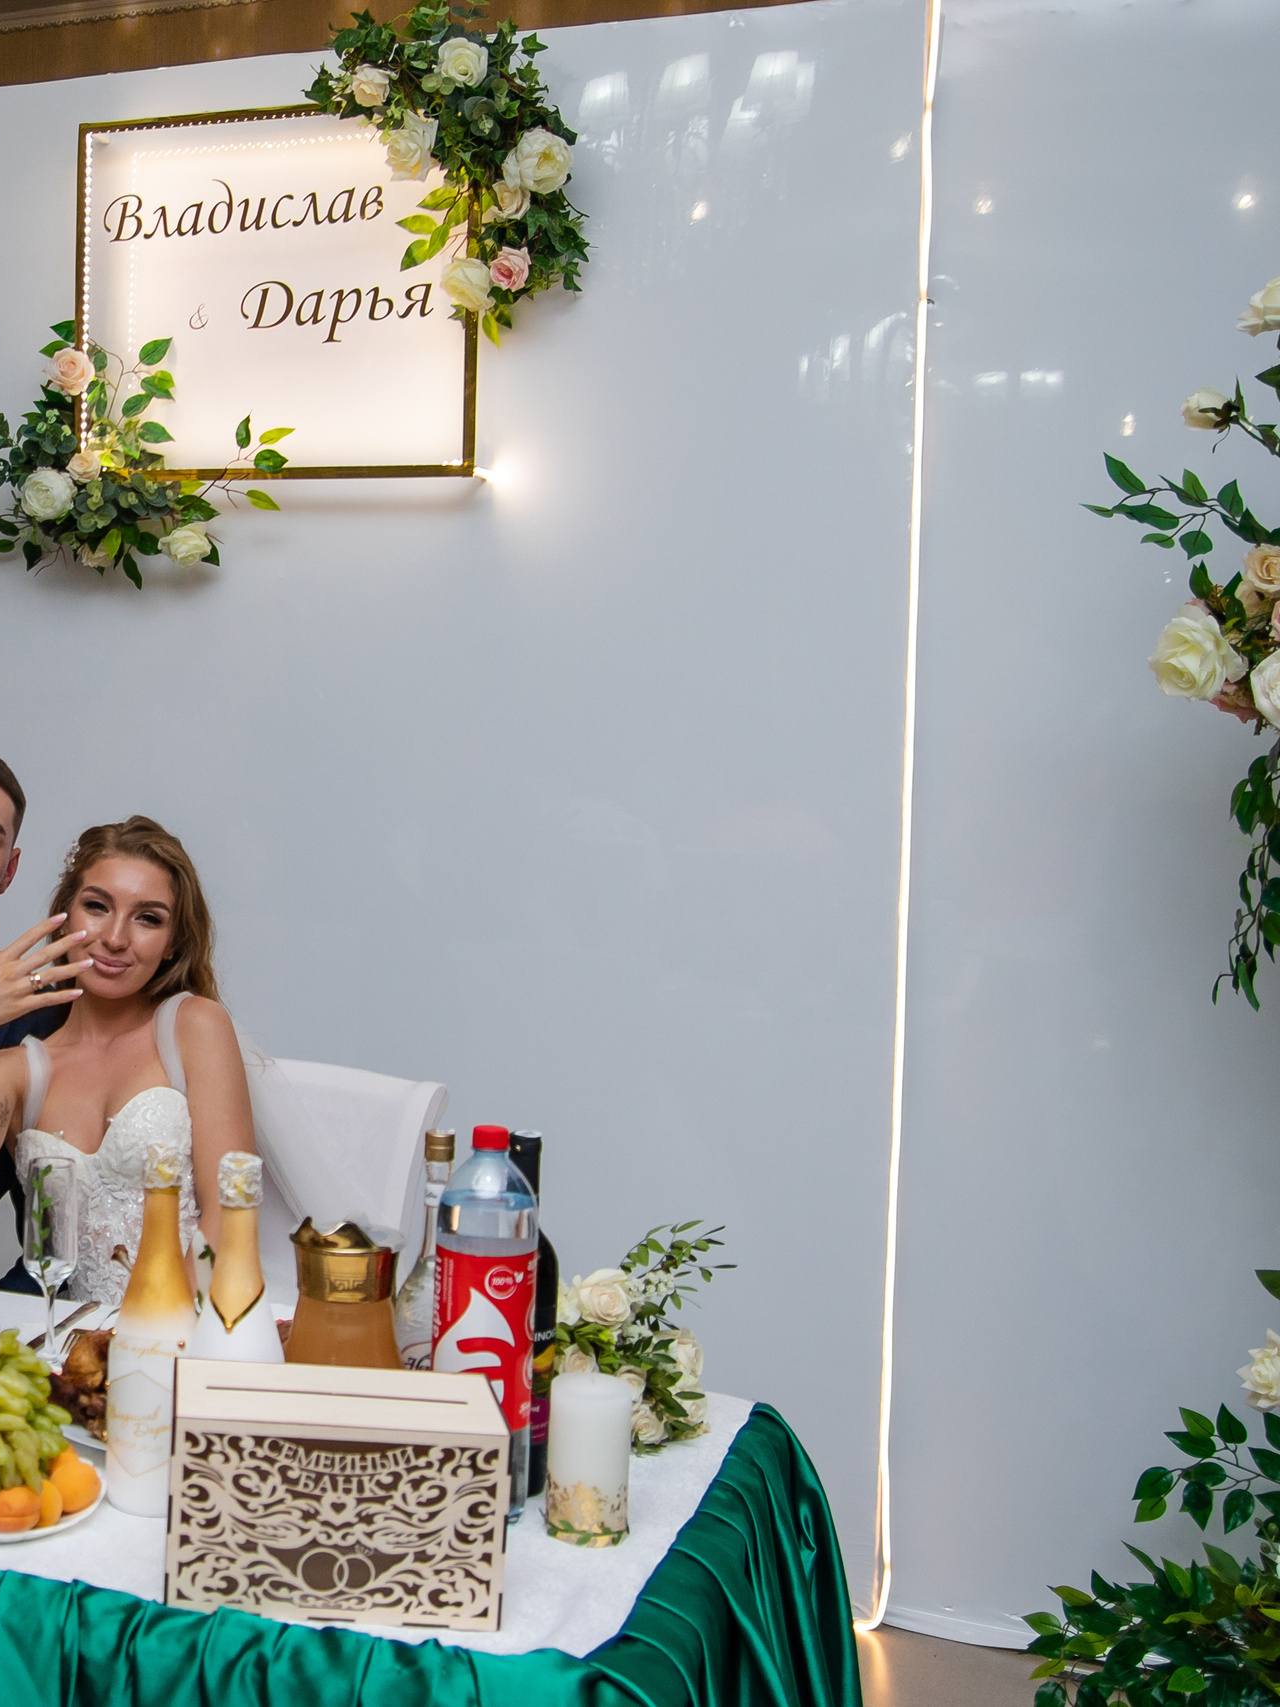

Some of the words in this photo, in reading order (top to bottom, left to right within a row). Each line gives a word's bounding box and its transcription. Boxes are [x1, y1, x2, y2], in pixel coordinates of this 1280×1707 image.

[103, 179, 385, 243] Владислав
[188, 303, 209, 330] &
[240, 280, 434, 344] Дарья
[298, 1472, 383, 1496] БАНК
